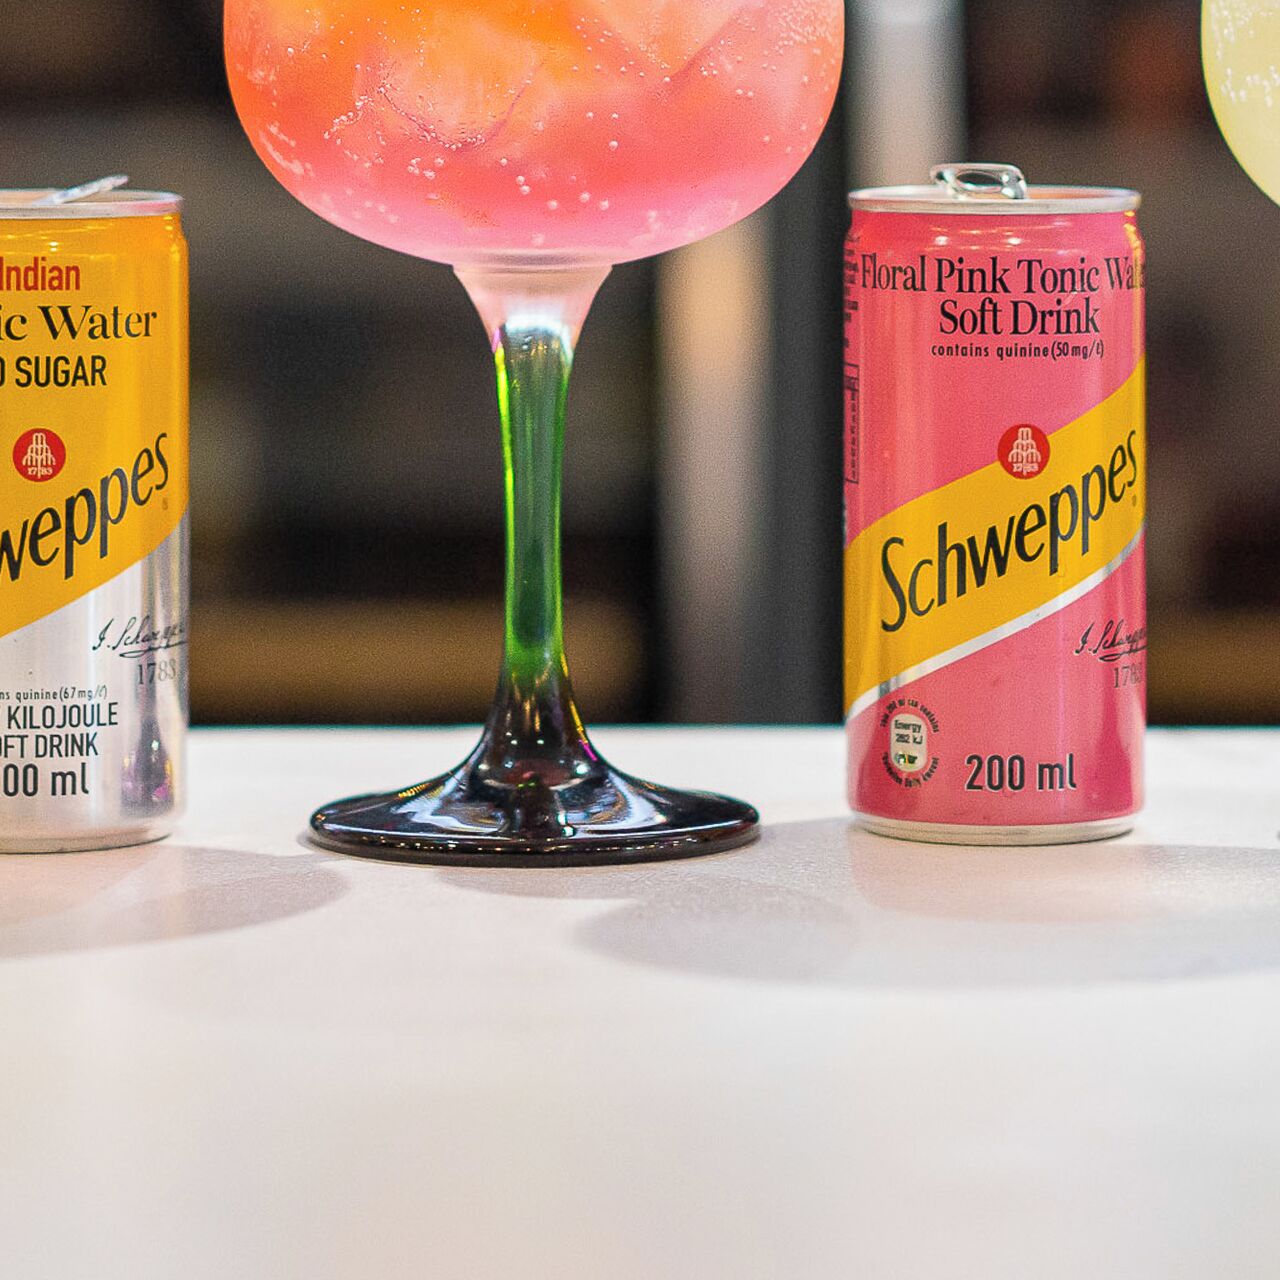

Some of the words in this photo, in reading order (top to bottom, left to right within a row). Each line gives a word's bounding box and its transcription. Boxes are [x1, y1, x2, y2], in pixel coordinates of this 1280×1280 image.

[861, 253, 927, 292] Floral
[935, 256, 1010, 294] Pink
[1017, 256, 1100, 294] Tonic
[37, 305, 157, 340] Water
[939, 297, 1003, 335] Soft
[1010, 297, 1100, 335] Drink
[931, 343, 989, 357] contains
[15, 355, 107, 387] SUGAR
[881, 429, 1136, 633] Schweppes
[8, 702, 118, 729] KILOJOULE
[894, 720, 922, 733] Energy
[35, 732, 98, 758] DRINK
[51, 762, 90, 796] ml
[966, 754, 1025, 790] 200
[1037, 754, 1077, 790] ml
